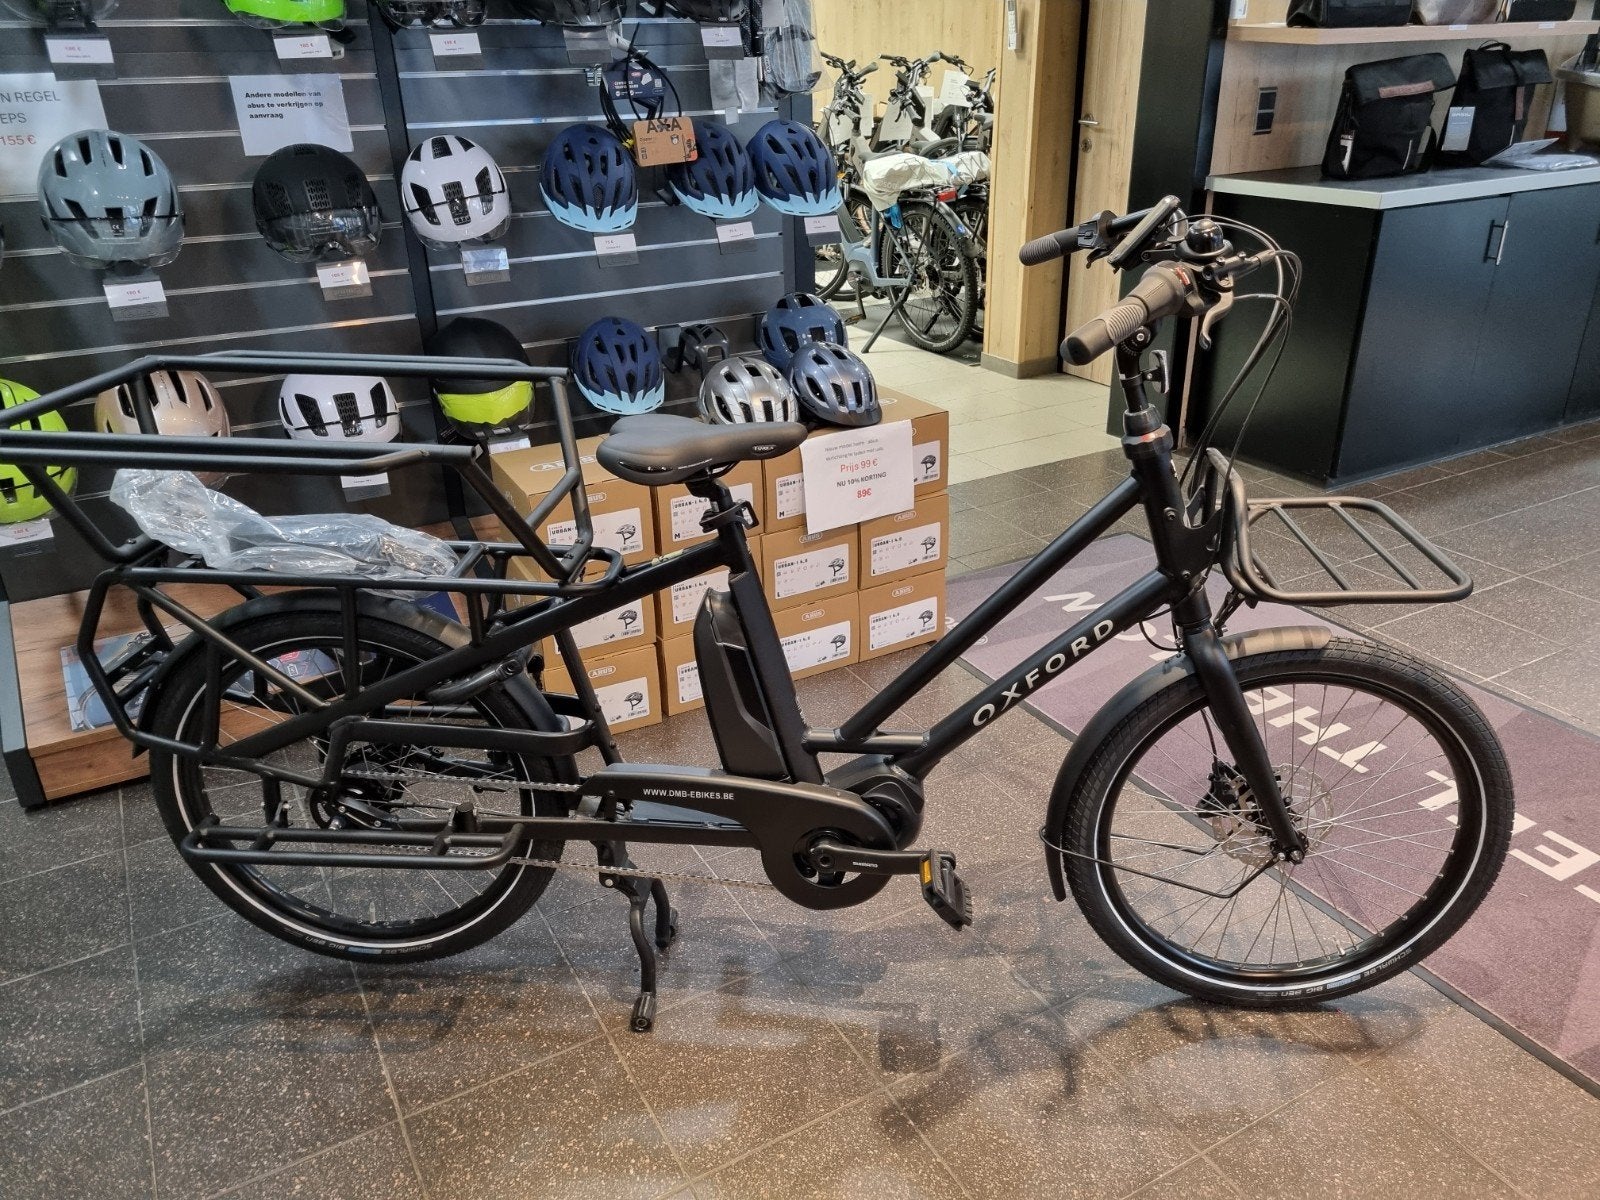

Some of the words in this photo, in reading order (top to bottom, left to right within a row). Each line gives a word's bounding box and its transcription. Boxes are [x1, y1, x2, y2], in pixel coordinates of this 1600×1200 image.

[14, 90, 61, 103] REGEL
[647, 117, 682, 134] AXA
[840, 462, 859, 473] Prijs
[860, 459, 871, 469] 99
[872, 458, 879, 466] €
[847, 477, 860, 486] 10%
[860, 471, 887, 482] KORTING
[857, 488, 872, 498] 89€
[551, 526, 577, 535] URBAN-
[592, 667, 613, 677] ABUS
[973, 619, 1114, 726] OXFORD
[1244, 687, 1388, 774] THE
[643, 788, 735, 800] WWW.DMB-EBIKES.BE
[1363, 947, 1412, 977] SCHWALBE
[1305, 985, 1324, 994] BIG
